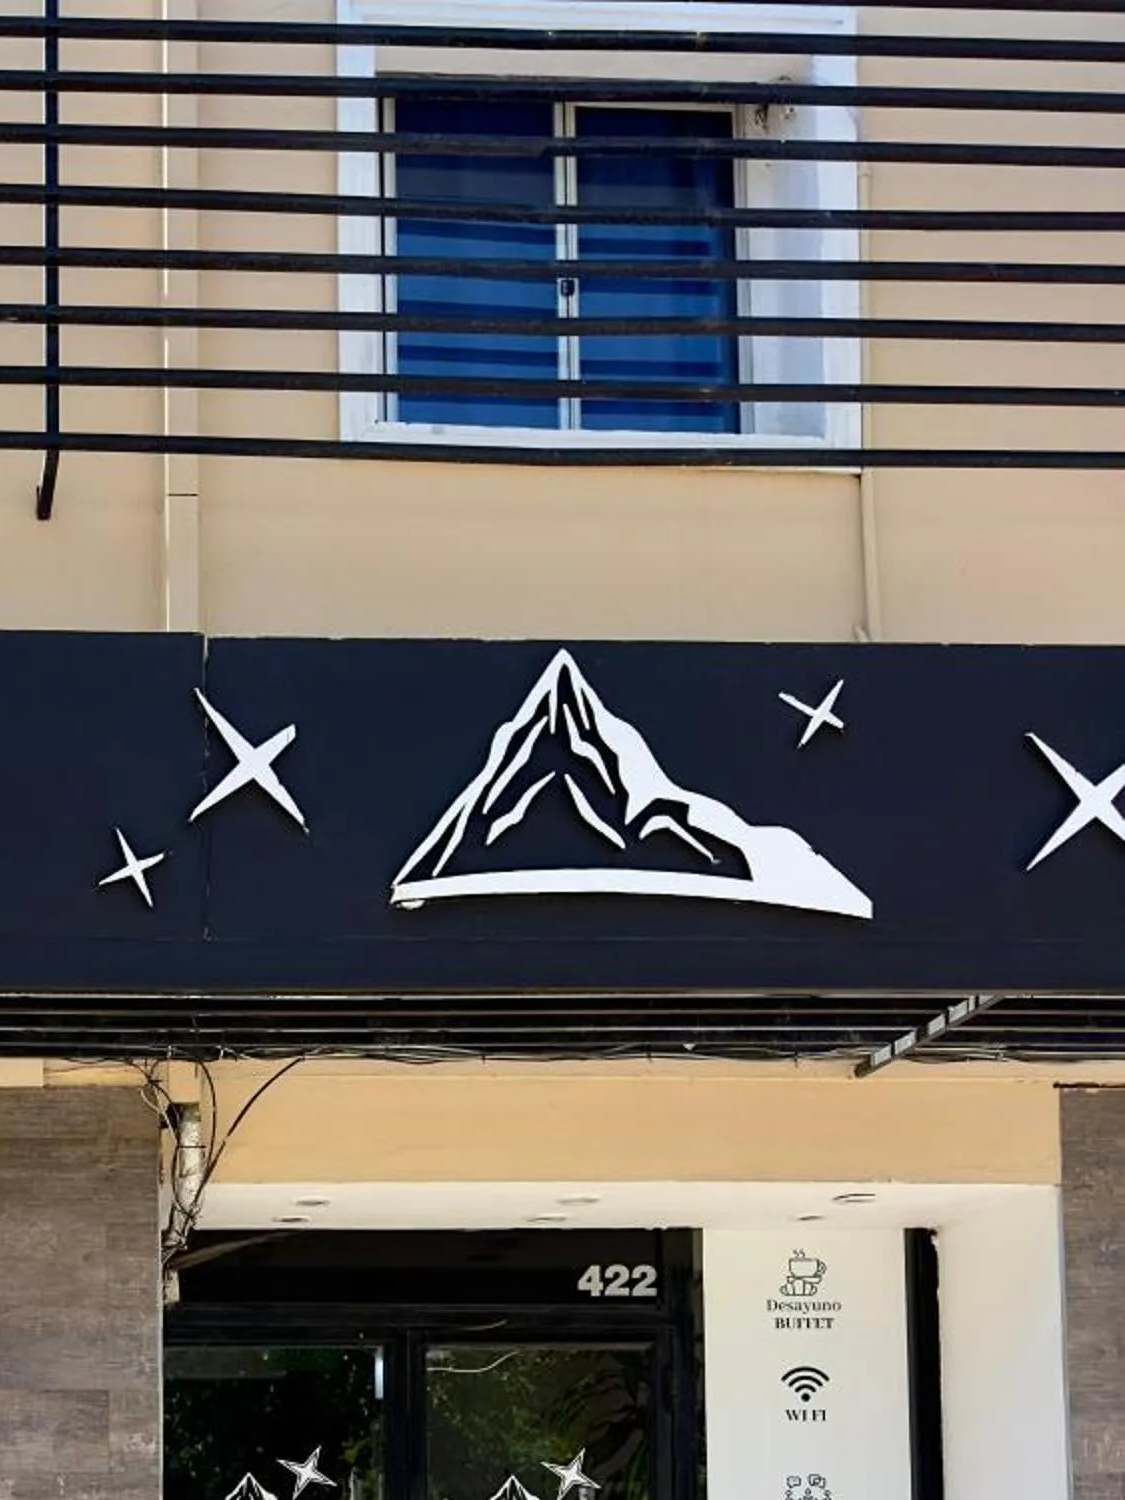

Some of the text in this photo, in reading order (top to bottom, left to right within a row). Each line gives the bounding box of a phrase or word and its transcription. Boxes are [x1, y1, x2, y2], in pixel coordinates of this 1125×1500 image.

[577, 1263, 658, 1297] 422
[766, 1299, 842, 1314] Desayuno
[774, 1317, 835, 1330] BUFFET
